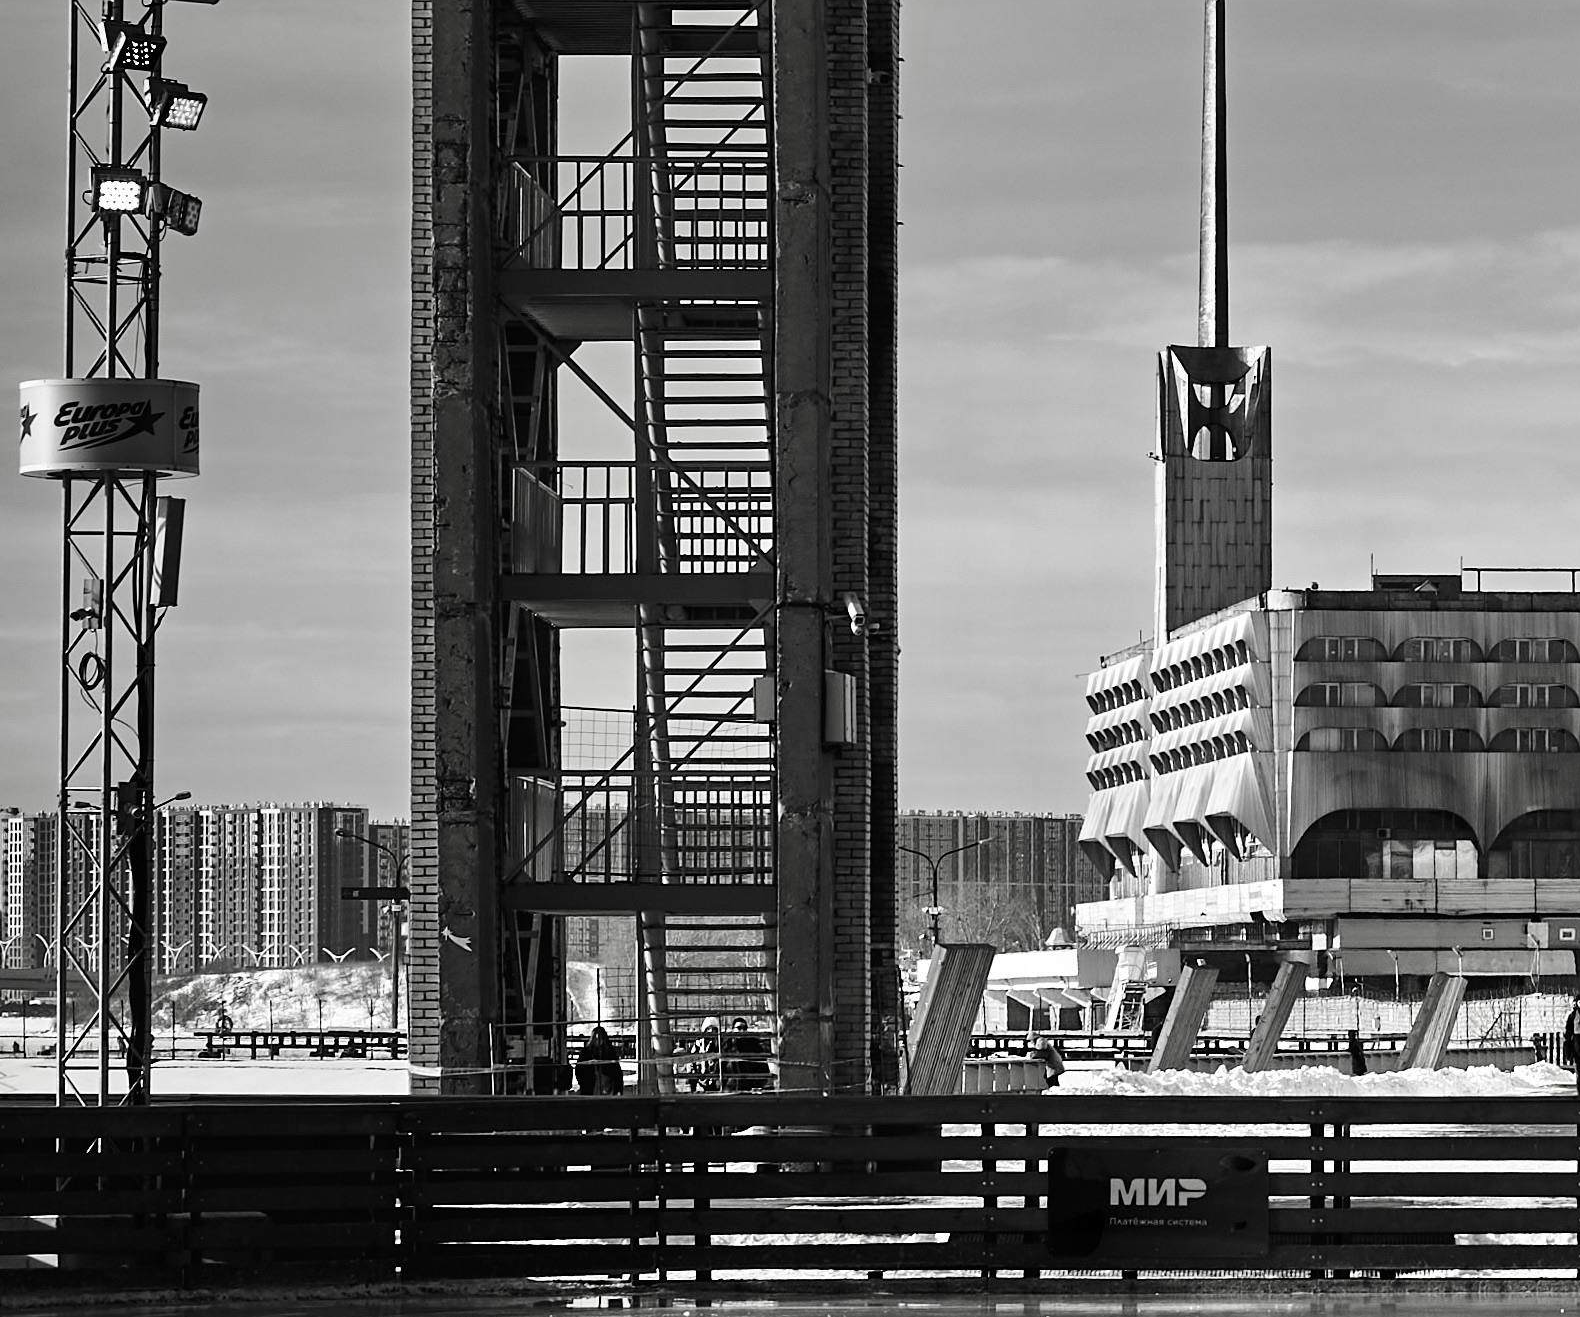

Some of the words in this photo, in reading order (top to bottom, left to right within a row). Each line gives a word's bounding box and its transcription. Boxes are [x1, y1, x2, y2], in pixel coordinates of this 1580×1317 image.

[54, 401, 146, 427] Europa
[1109, 1178, 1208, 1207] МИР
[1109, 1217, 1165, 1227] Платёжная
[1167, 1219, 1208, 1227] система
